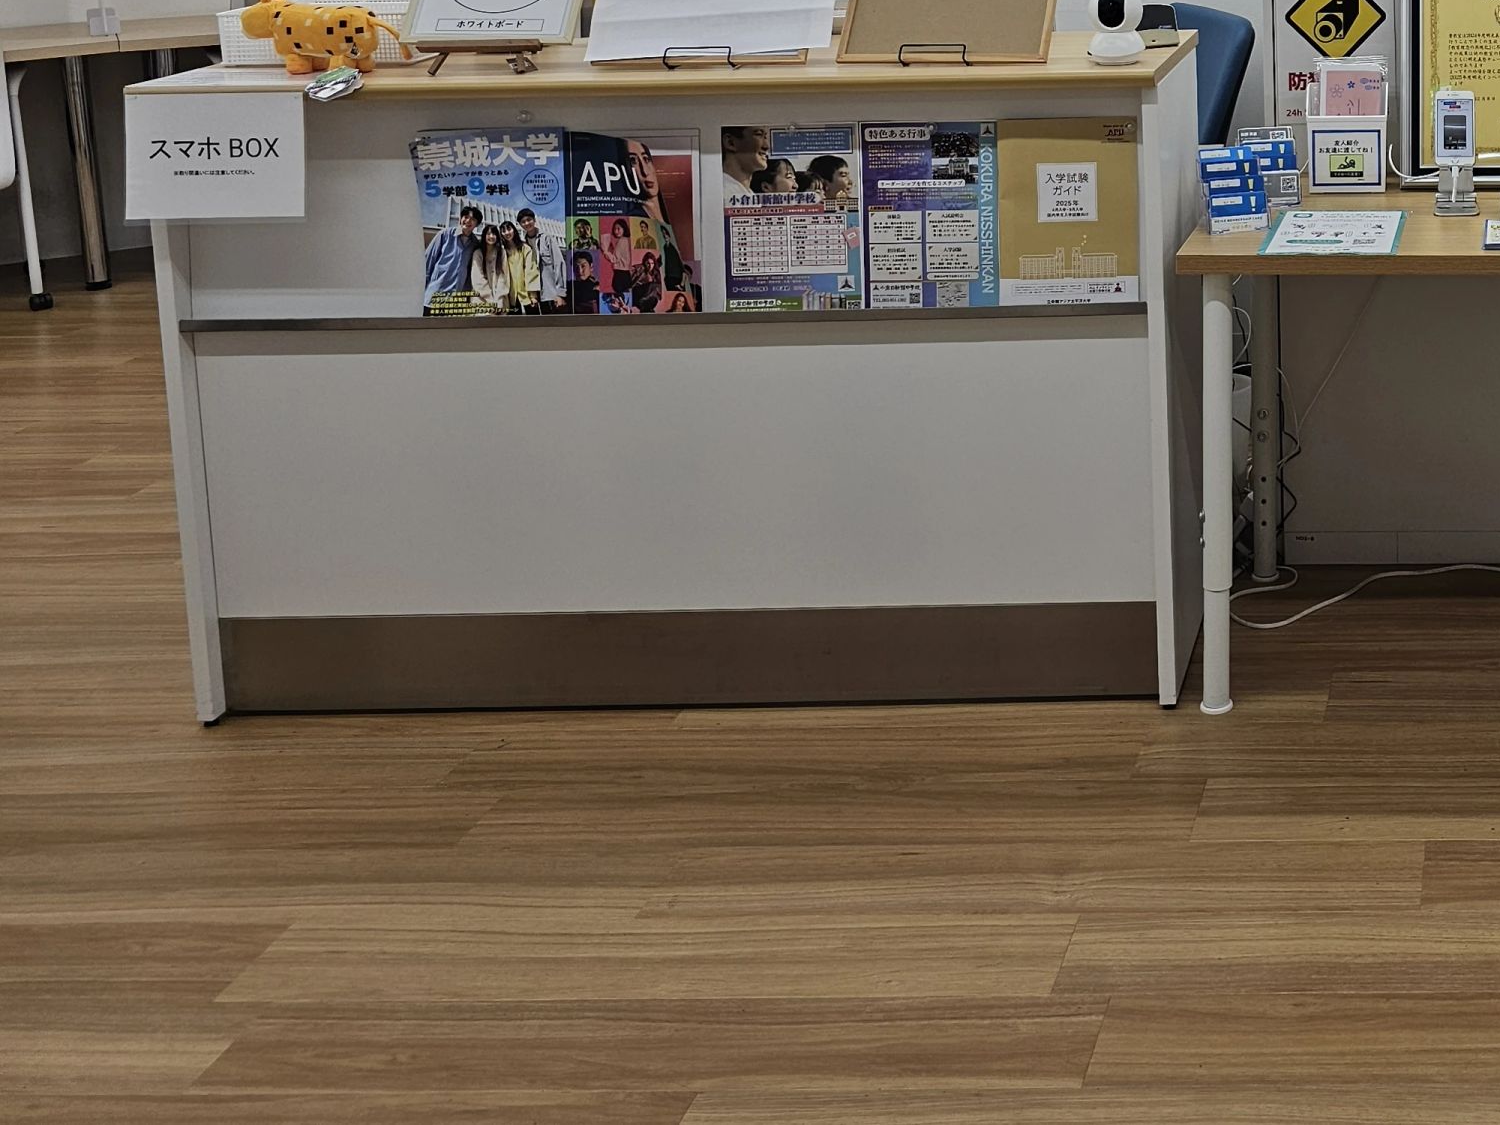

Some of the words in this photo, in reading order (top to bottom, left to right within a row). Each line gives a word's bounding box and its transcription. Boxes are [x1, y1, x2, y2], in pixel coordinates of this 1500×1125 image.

[456, 20, 524, 28] ホワイトボード
[1286, 109, 1303, 117] 24h
[868, 129, 927, 139] 特色ある行事
[150, 136, 221, 160] スマホ
[229, 138, 280, 158] BOX
[417, 133, 560, 170] 崇城大学
[576, 161, 640, 195] APU
[980, 143, 993, 203] KOKURA
[1045, 173, 1089, 184] 入学試験
[425, 177, 511, 197] 5学部9学科
[1053, 186, 1082, 195] ガイド
[729, 194, 816, 206] 小倉日新館中学校
[980, 206, 994, 294] NISSHINKAN
